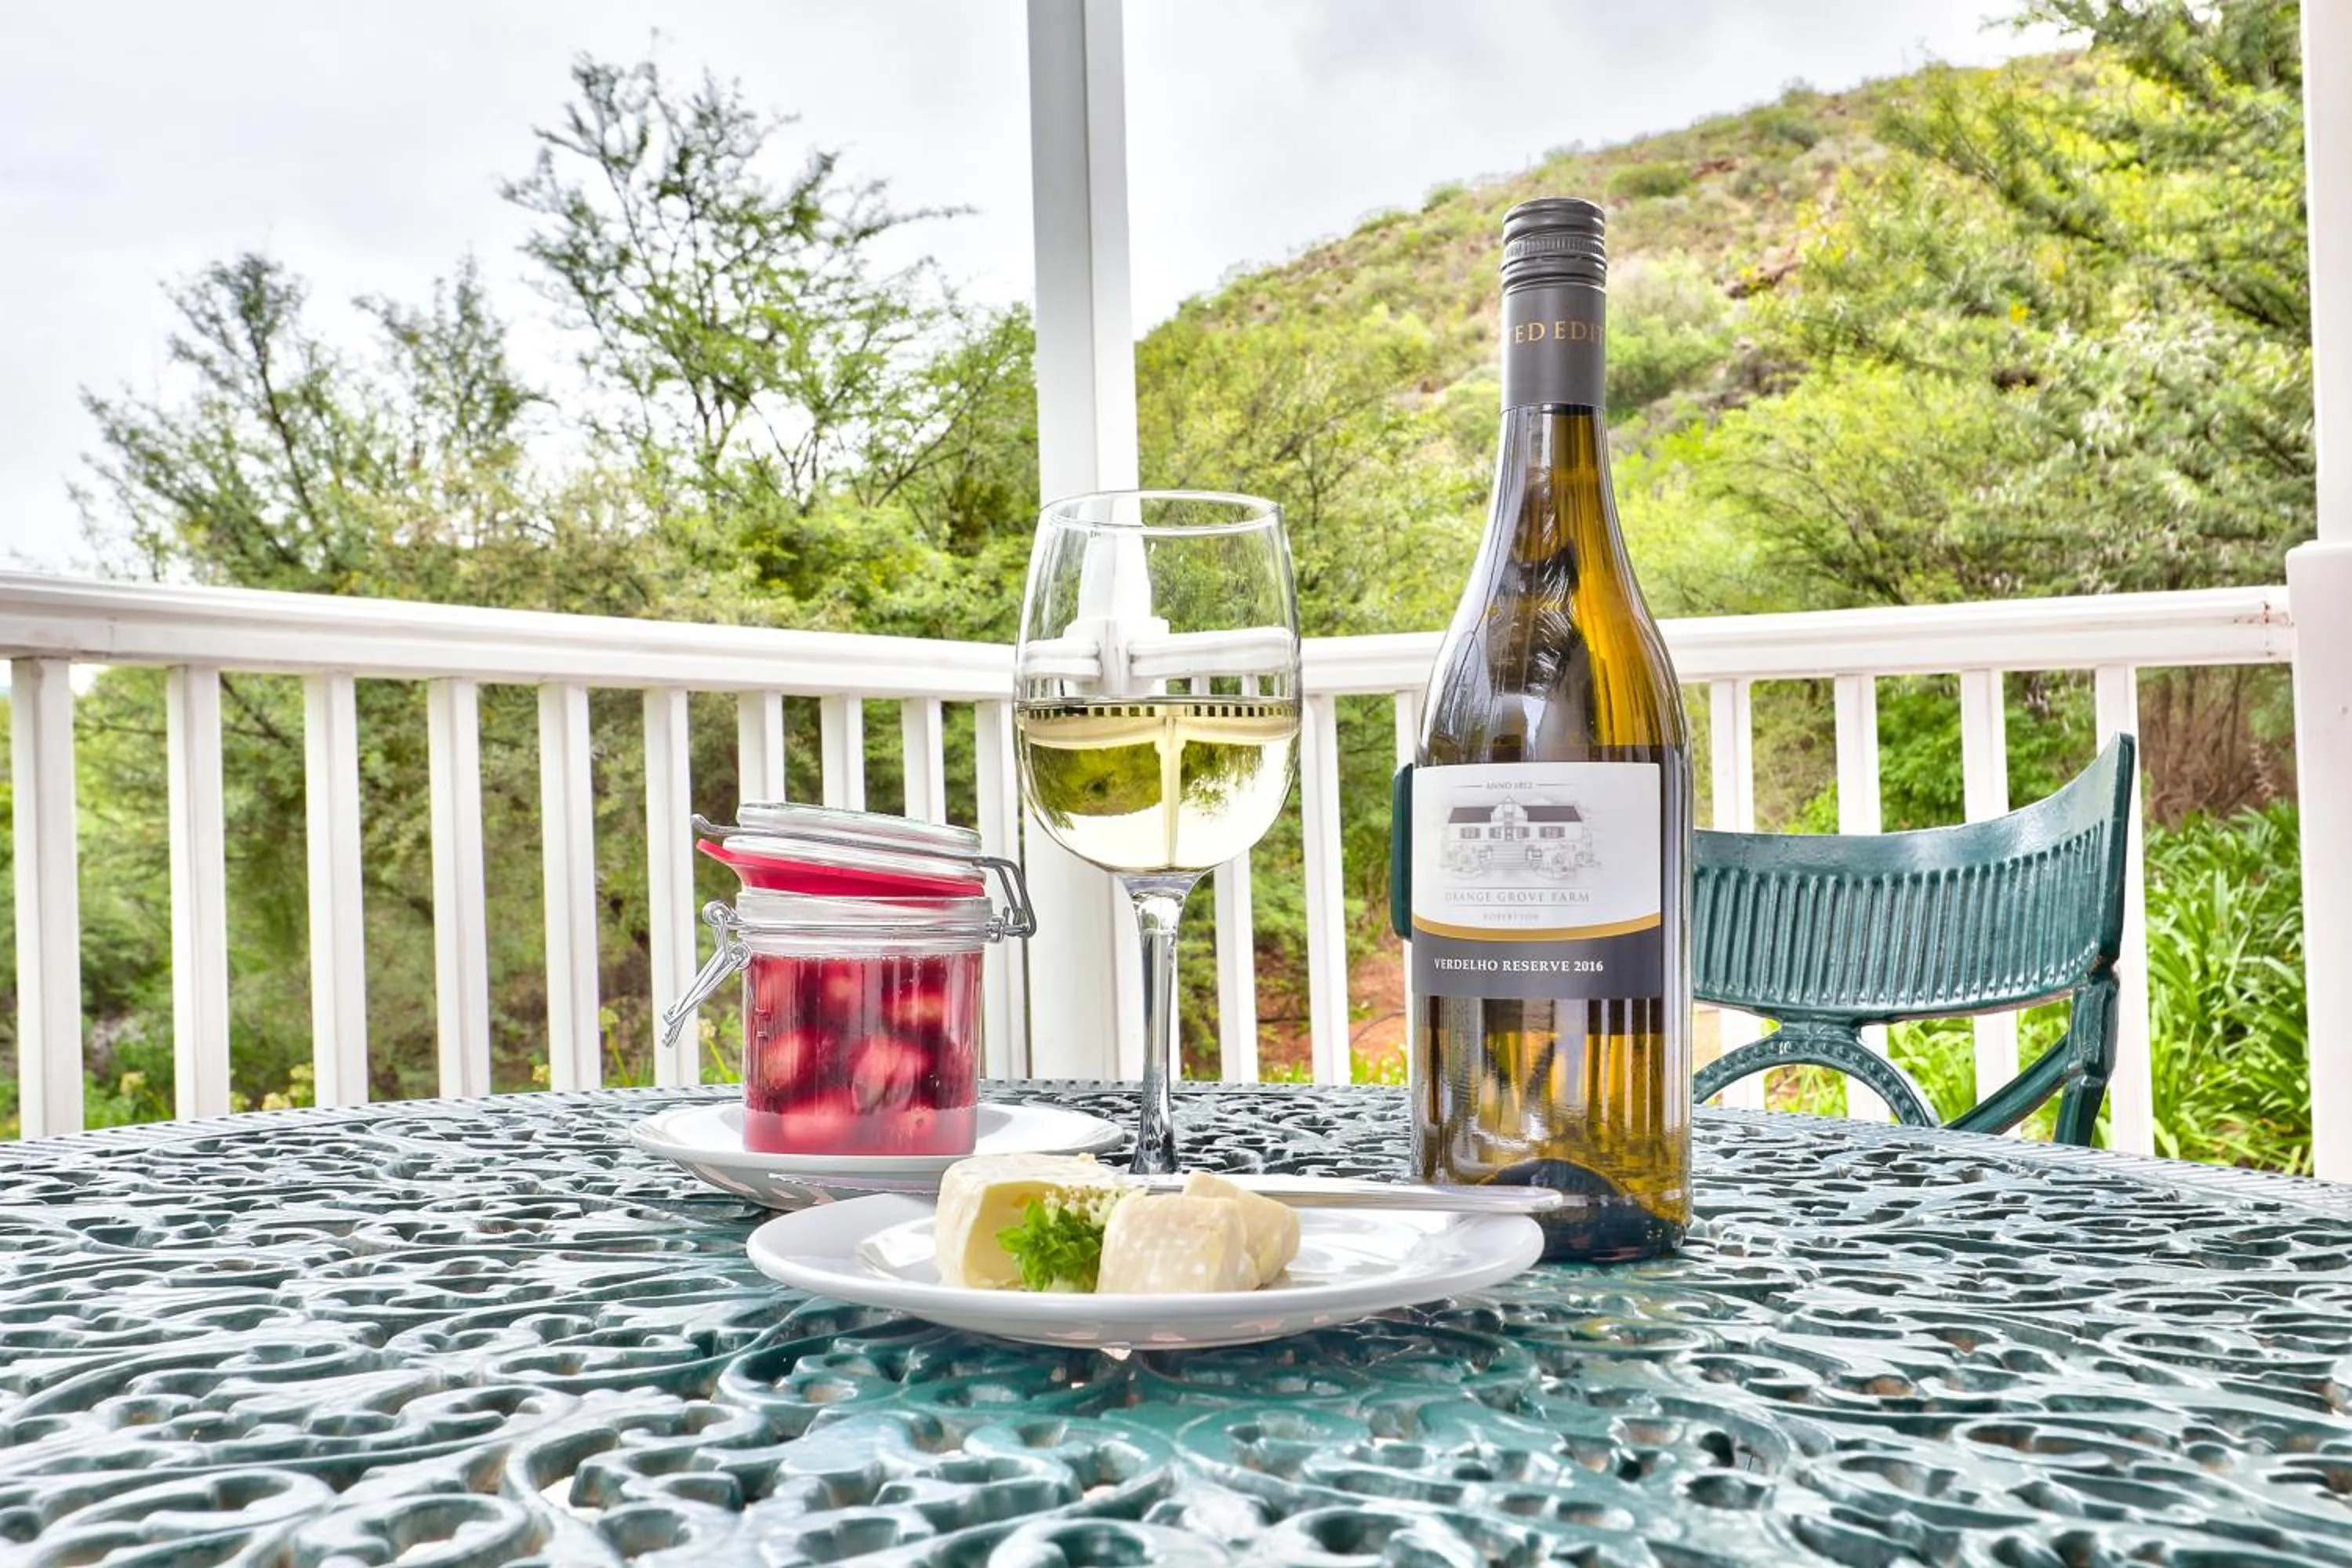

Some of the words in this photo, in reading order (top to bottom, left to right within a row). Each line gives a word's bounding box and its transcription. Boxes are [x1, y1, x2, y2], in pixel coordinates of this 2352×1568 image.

[1510, 321, 1546, 344] ED
[1497, 891, 1544, 902] GROVE
[1552, 891, 1589, 902] FARM
[1434, 957, 1497, 971] VERDELHO
[1502, 960, 1570, 972] RESERVE
[1574, 960, 1603, 971] 2016
